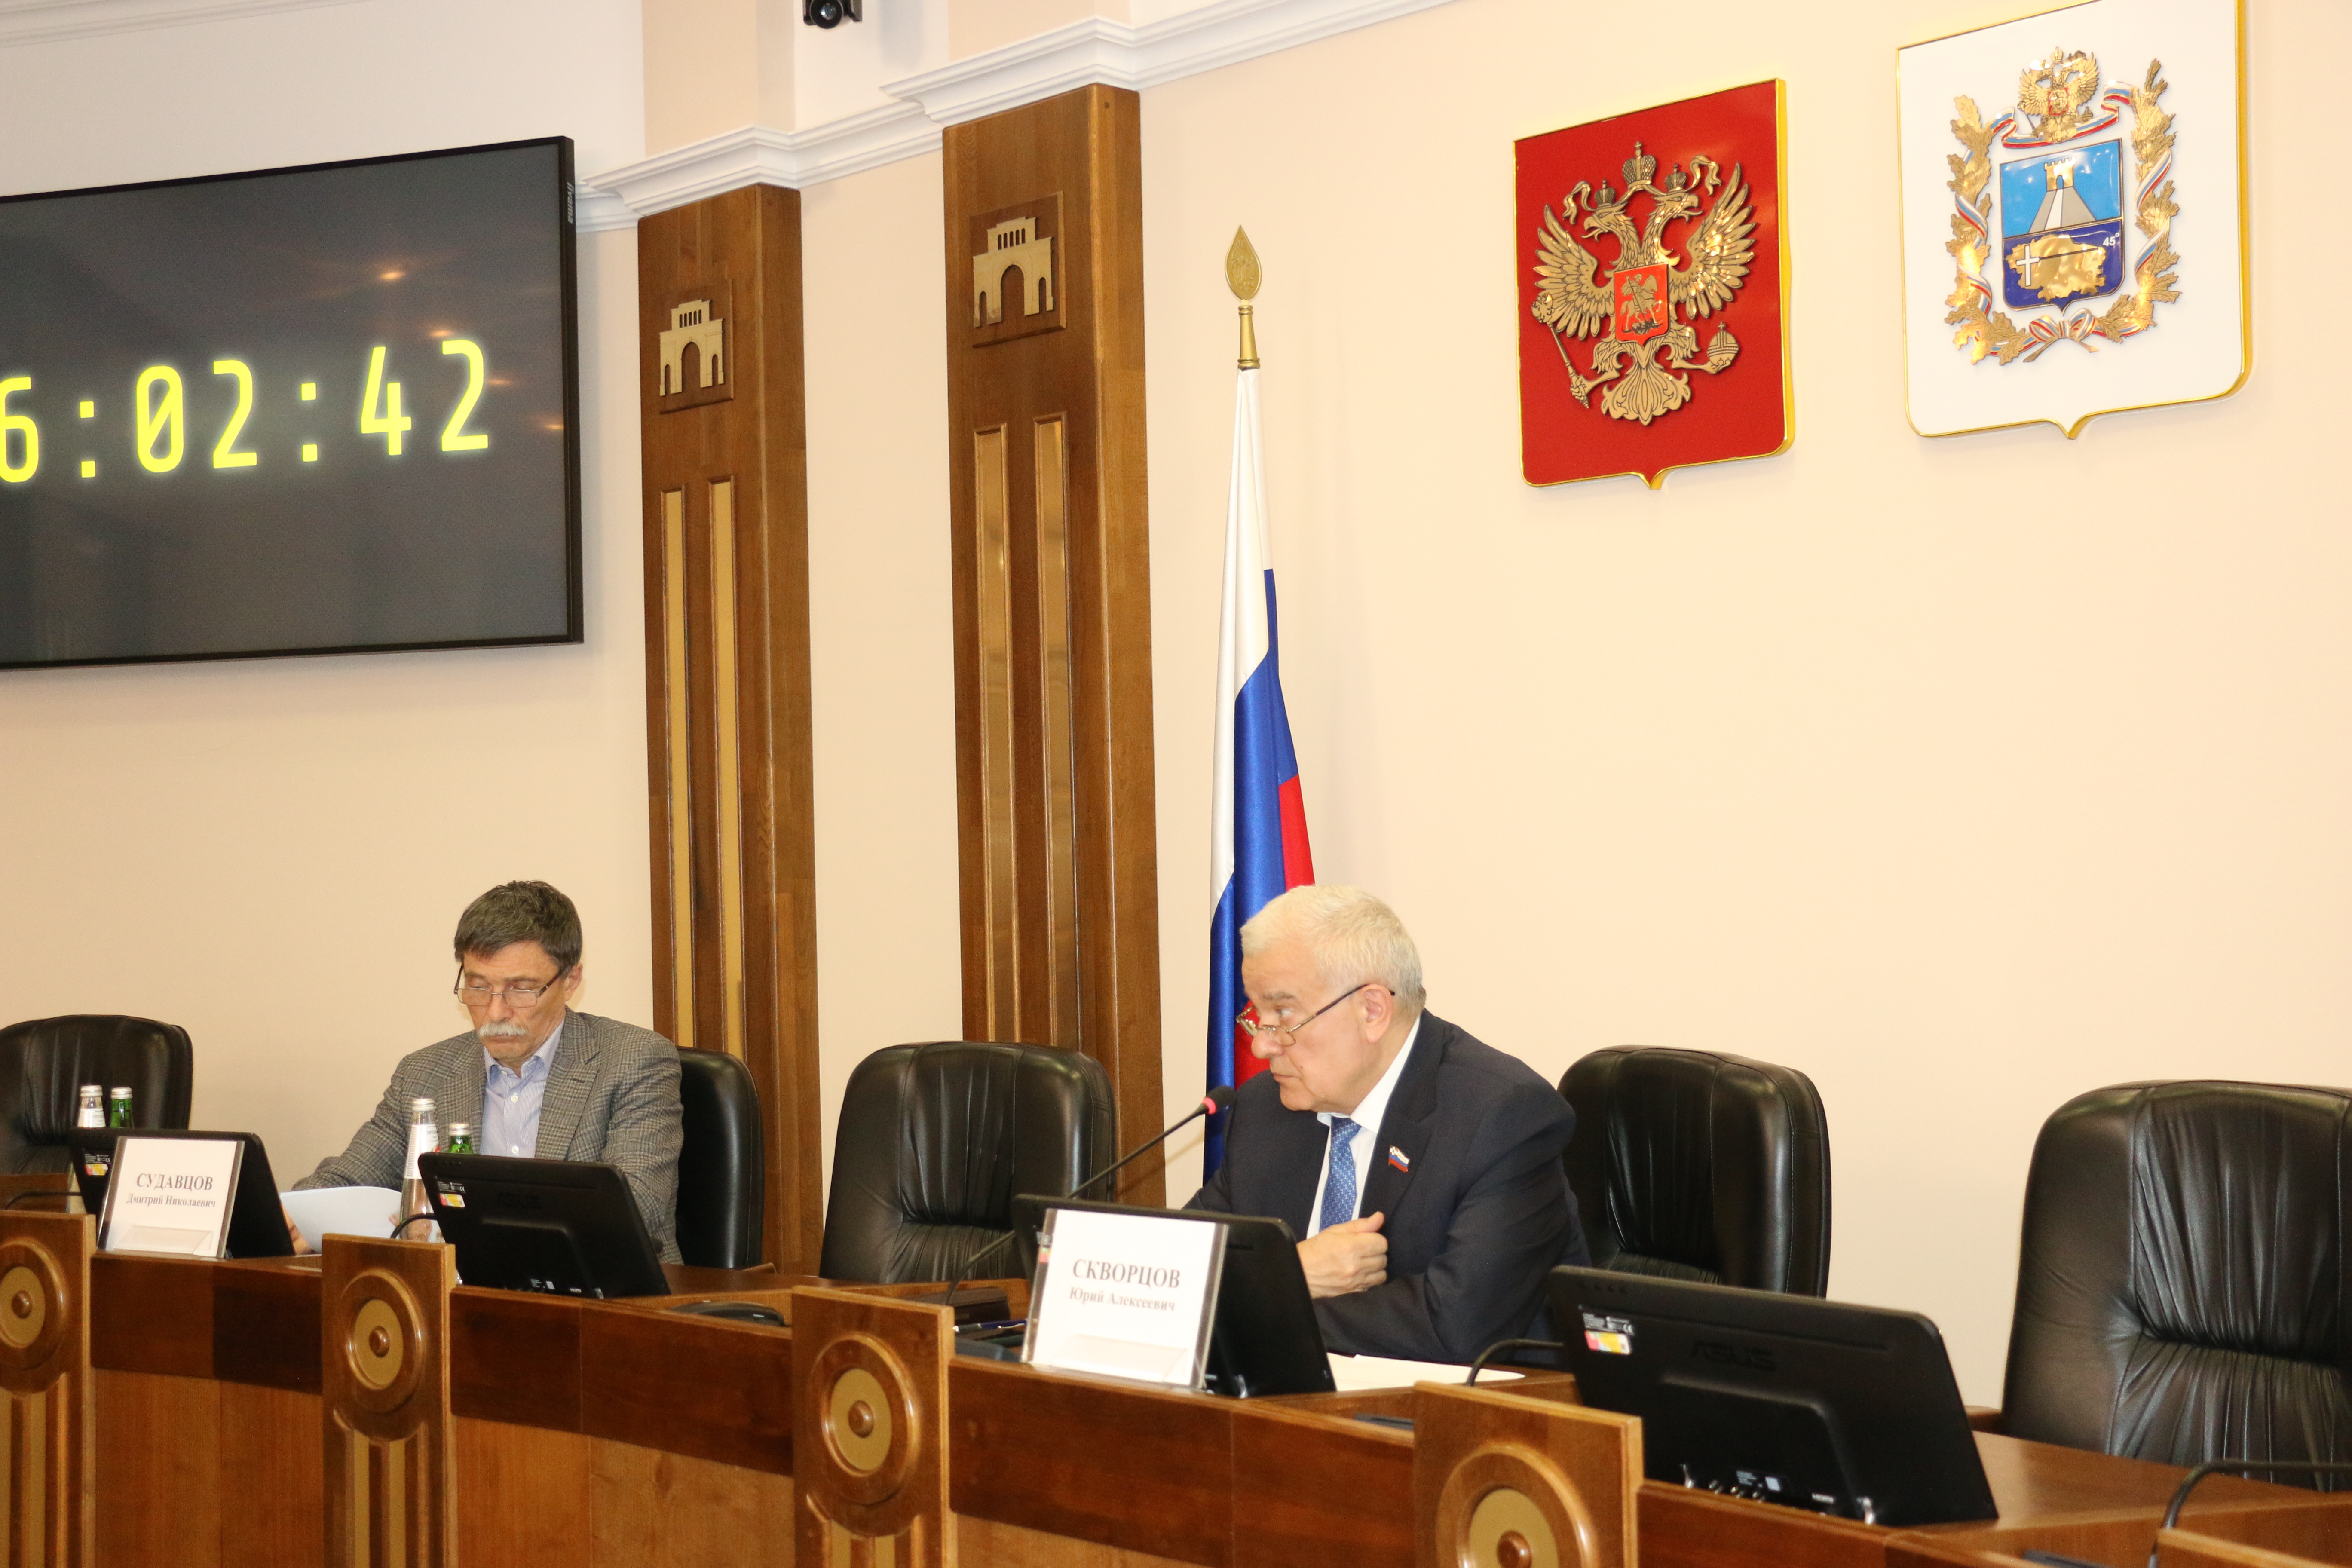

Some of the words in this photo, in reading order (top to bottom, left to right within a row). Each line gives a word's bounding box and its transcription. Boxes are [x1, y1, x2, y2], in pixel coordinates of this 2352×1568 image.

[137, 1173, 213, 1191] СУДАВЦОВ
[127, 1193, 163, 1206] Дмитрий
[165, 1195, 216, 1207] Николаевич
[1073, 1259, 1180, 1289] СКВОРЦОВ
[1069, 1286, 1104, 1305] Юрий
[1107, 1292, 1175, 1311] Алексеевич
